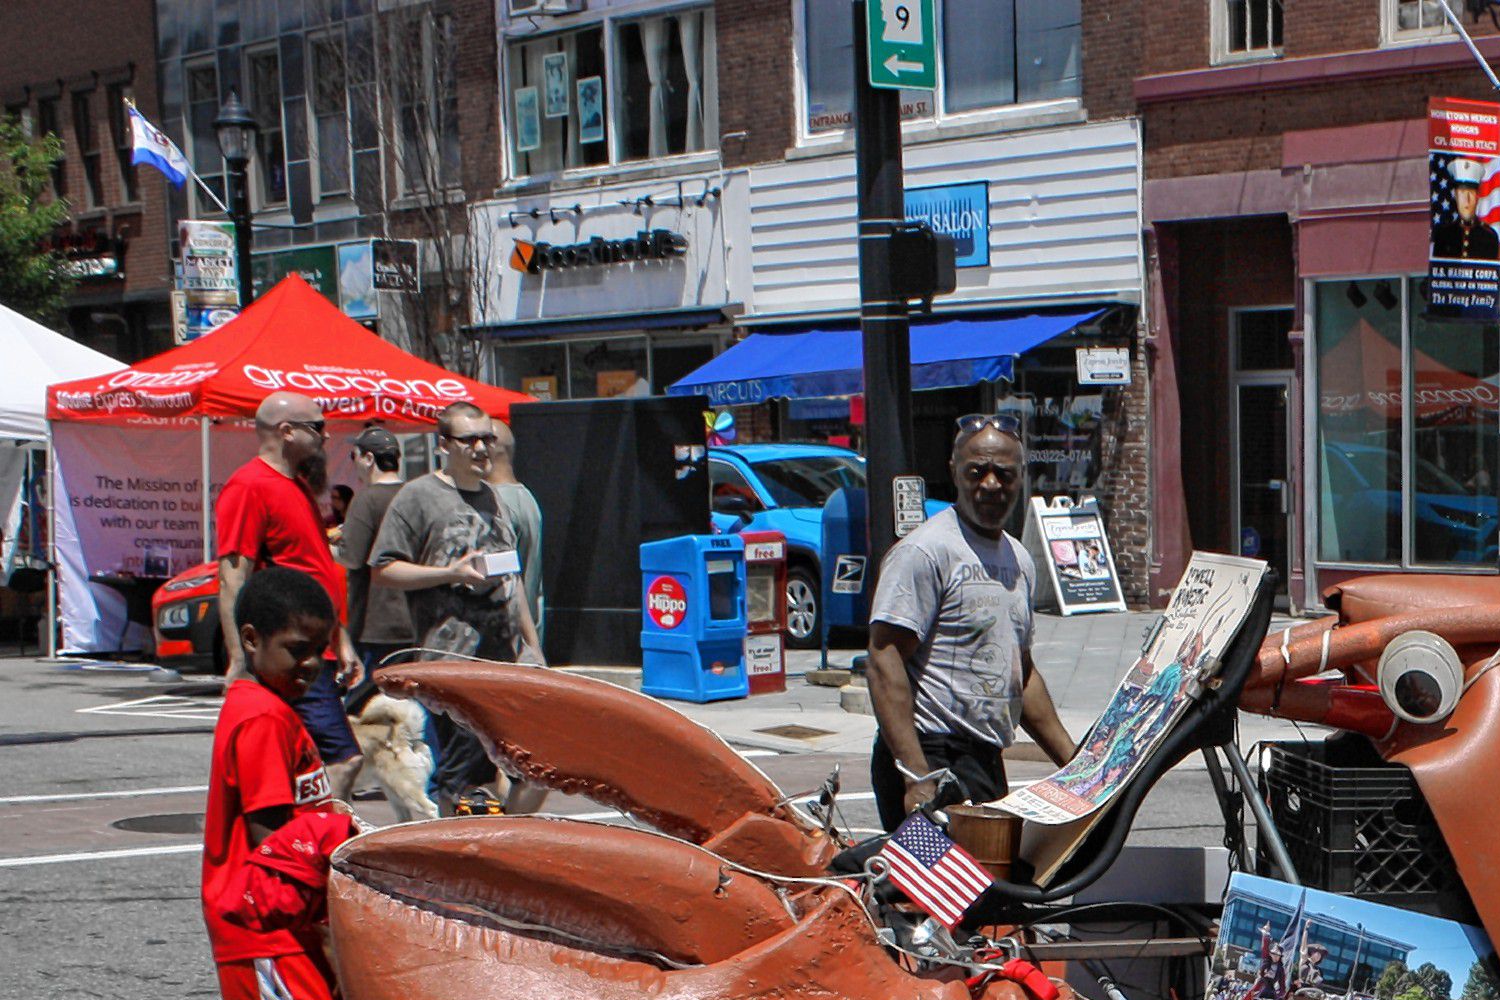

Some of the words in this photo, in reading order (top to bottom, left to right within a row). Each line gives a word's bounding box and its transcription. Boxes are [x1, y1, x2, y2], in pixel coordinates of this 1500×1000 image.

[895, 5, 910, 31] 9
[810, 112, 853, 129] ENTRANCE
[931, 209, 984, 233] SALON
[243, 363, 468, 398] grappone
[371, 392, 395, 412] To
[96, 475, 123, 491] The
[127, 477, 182, 494] Mission
[184, 479, 199, 493] of
[83, 495, 161, 512] dedication
[162, 499, 178, 512] to
[100, 515, 132, 530] with
[135, 518, 160, 531] our
[163, 517, 200, 532] team
[710, 539, 732, 548] FREE
[753, 547, 776, 559] free
[648, 592, 687, 615] Hippo
